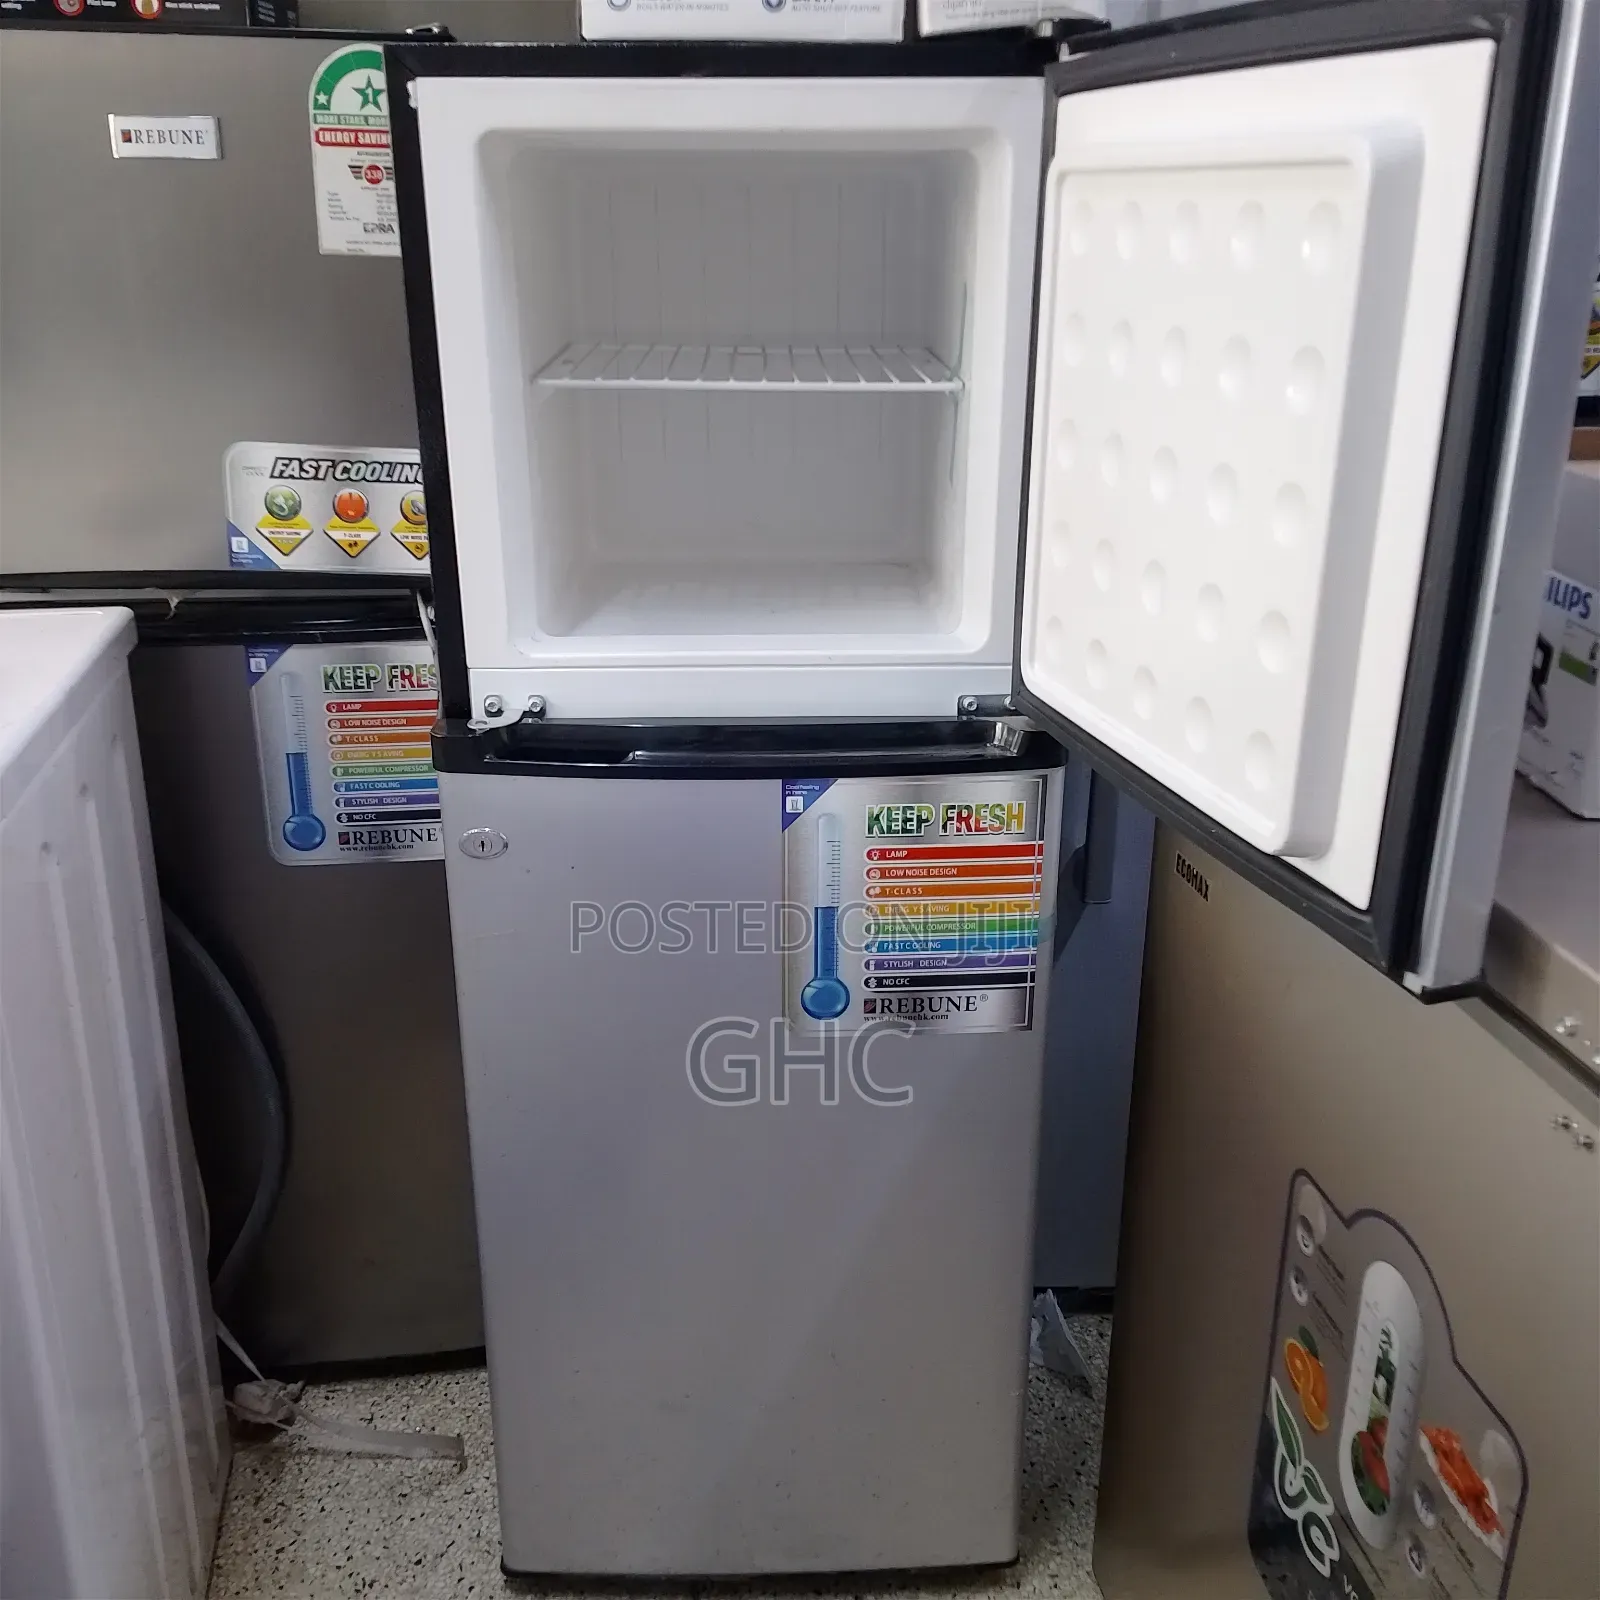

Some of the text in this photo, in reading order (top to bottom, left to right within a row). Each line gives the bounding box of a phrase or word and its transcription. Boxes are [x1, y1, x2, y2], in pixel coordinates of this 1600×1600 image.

[133, 129, 206, 145] REBUNE
[319, 130, 356, 144] ENERGY
[270, 457, 335, 481] FAST
[321, 663, 381, 693] KEEP
[342, 703, 362, 711] LAMP
[344, 719, 361, 727] LOW
[865, 800, 1027, 838] KEEP FRESH
[352, 828, 438, 845] REBUNE
[886, 850, 908, 858] LAMP
[885, 868, 957, 877] LOW NOISE DESIGN
[1176, 852, 1209, 902] ECOMAX
[884, 887, 923, 895] T-CLASS
[884, 922, 976, 932] POWERFUL COMPRESSOR
[883, 942, 905, 950] FAST
[883, 959, 948, 968] STYLISH DESIGN
[883, 978, 896, 986] NO
